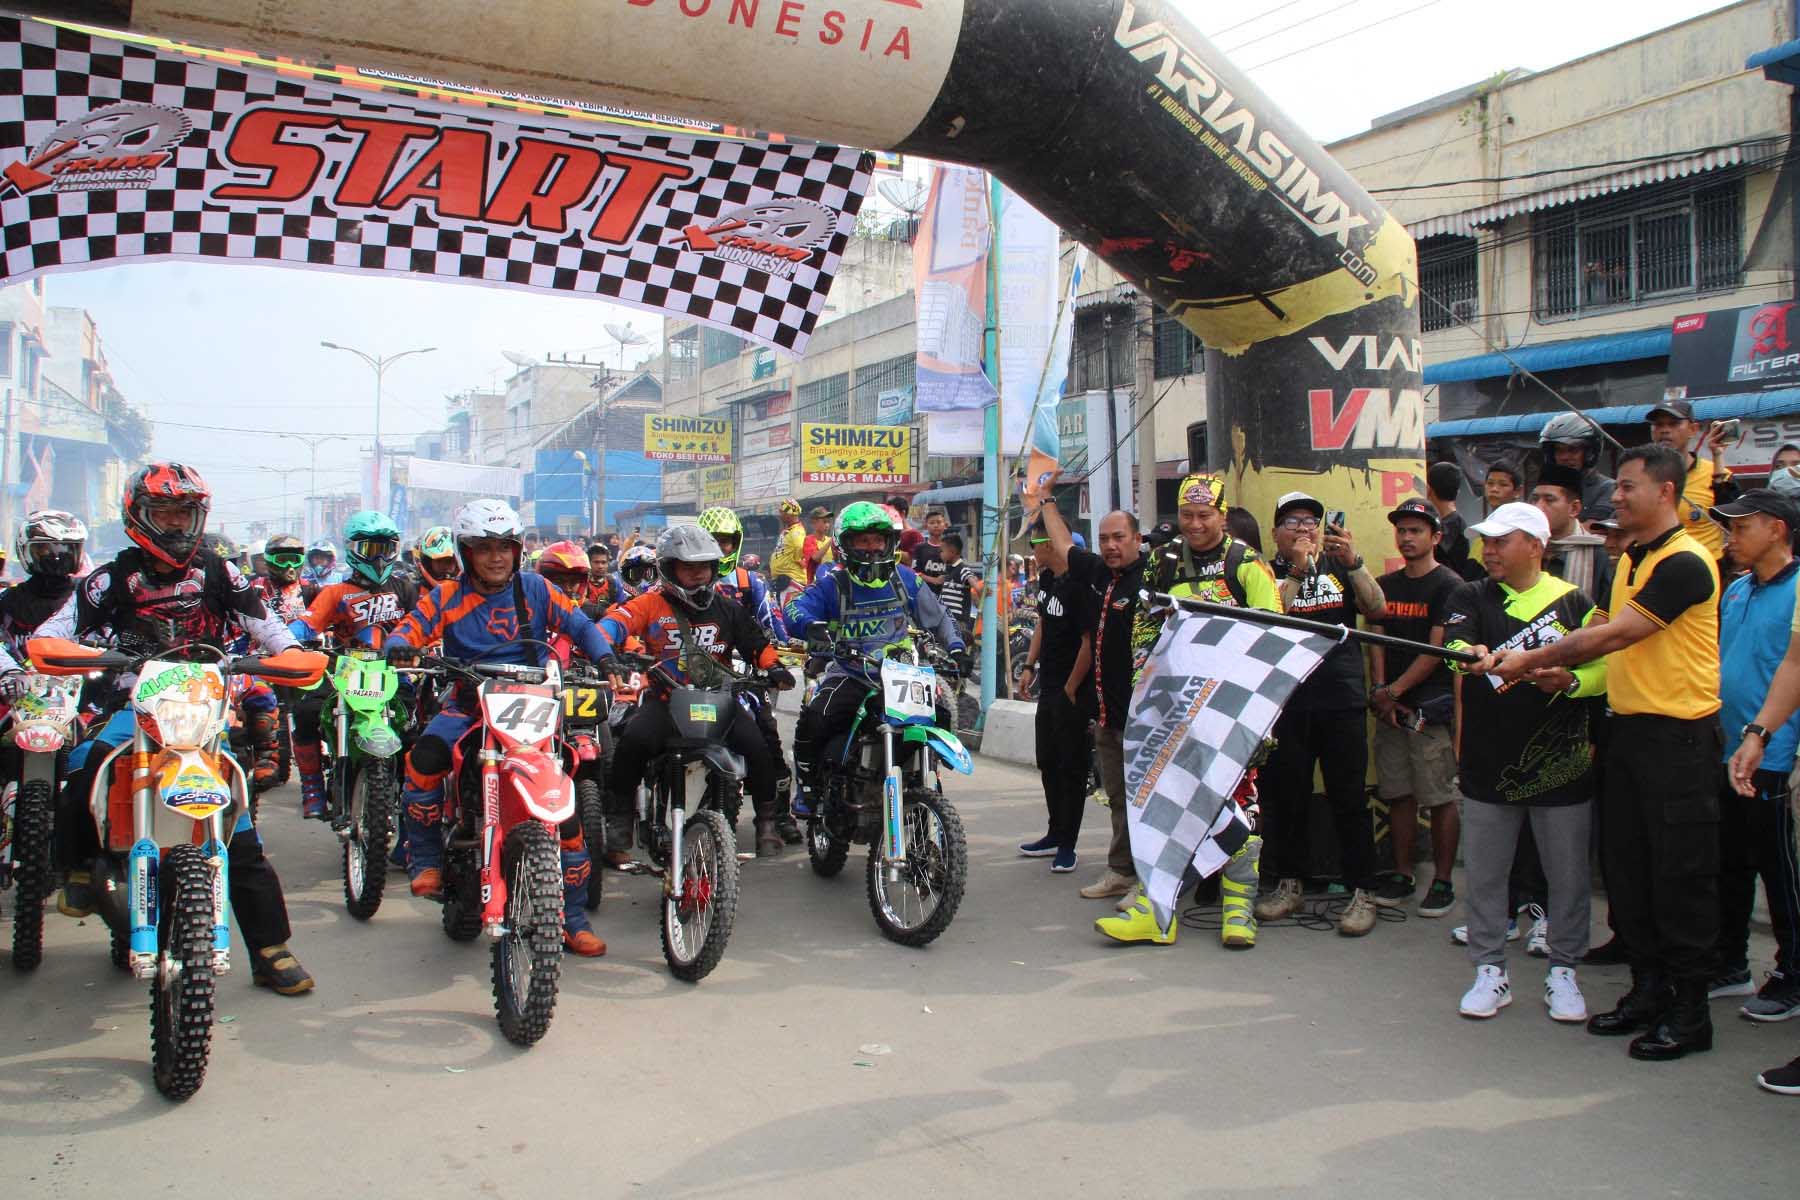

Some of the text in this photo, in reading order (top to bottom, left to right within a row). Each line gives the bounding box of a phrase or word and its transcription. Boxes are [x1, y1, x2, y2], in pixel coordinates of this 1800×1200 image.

[1160, 95, 1202, 135] INDONESIA
[1199, 130, 1230, 161] ONLINE
[1224, 153, 1268, 192] MOTOSHOP
[56, 168, 157, 183] INDONESIA
[210, 107, 694, 245] START
[714, 246, 796, 279] INDONESIA
[1676, 318, 1700, 329] NEW
[652, 417, 726, 434] SHIMIZU
[810, 427, 904, 448] SHIMIZU
[651, 452, 726, 462] TOKO BESI UTAMA
[810, 446, 858, 457] Bintangnya
[810, 472, 904, 483] SINAR MAJU
[564, 687, 598, 718] 12
[891, 679, 934, 708] 701
[495, 697, 556, 733] 44
